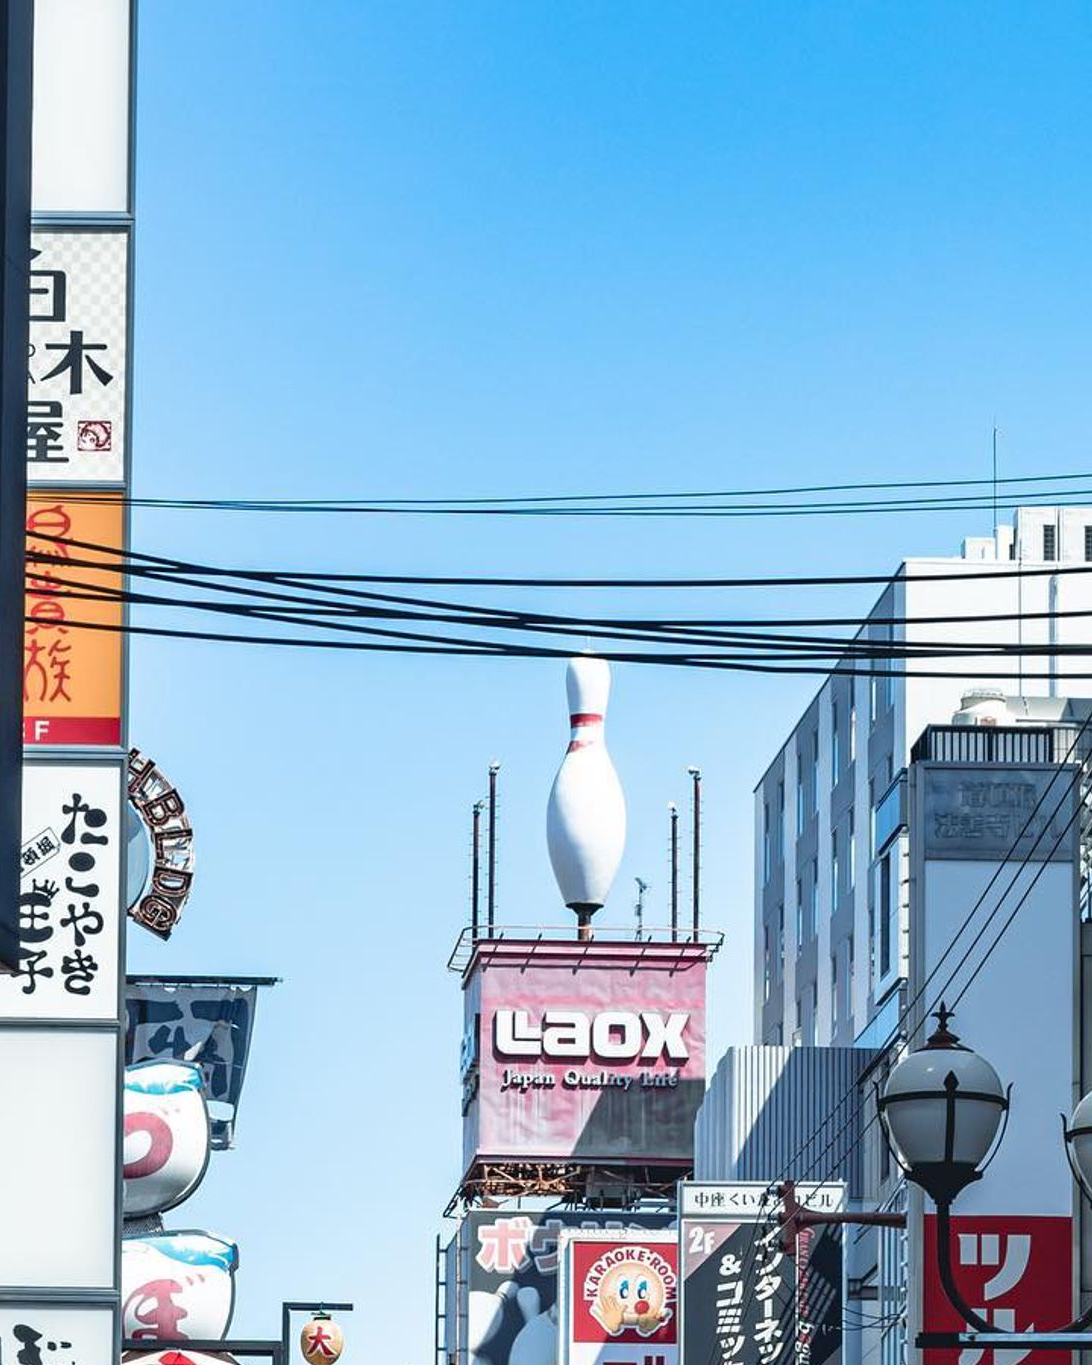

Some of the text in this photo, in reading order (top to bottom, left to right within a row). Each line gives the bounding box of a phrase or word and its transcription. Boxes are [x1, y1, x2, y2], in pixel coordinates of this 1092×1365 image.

[60, 793, 109, 995] たこやき
[503, 1070, 678, 1089] Japan Quality Life
[690, 1227, 715, 1254] 2F
